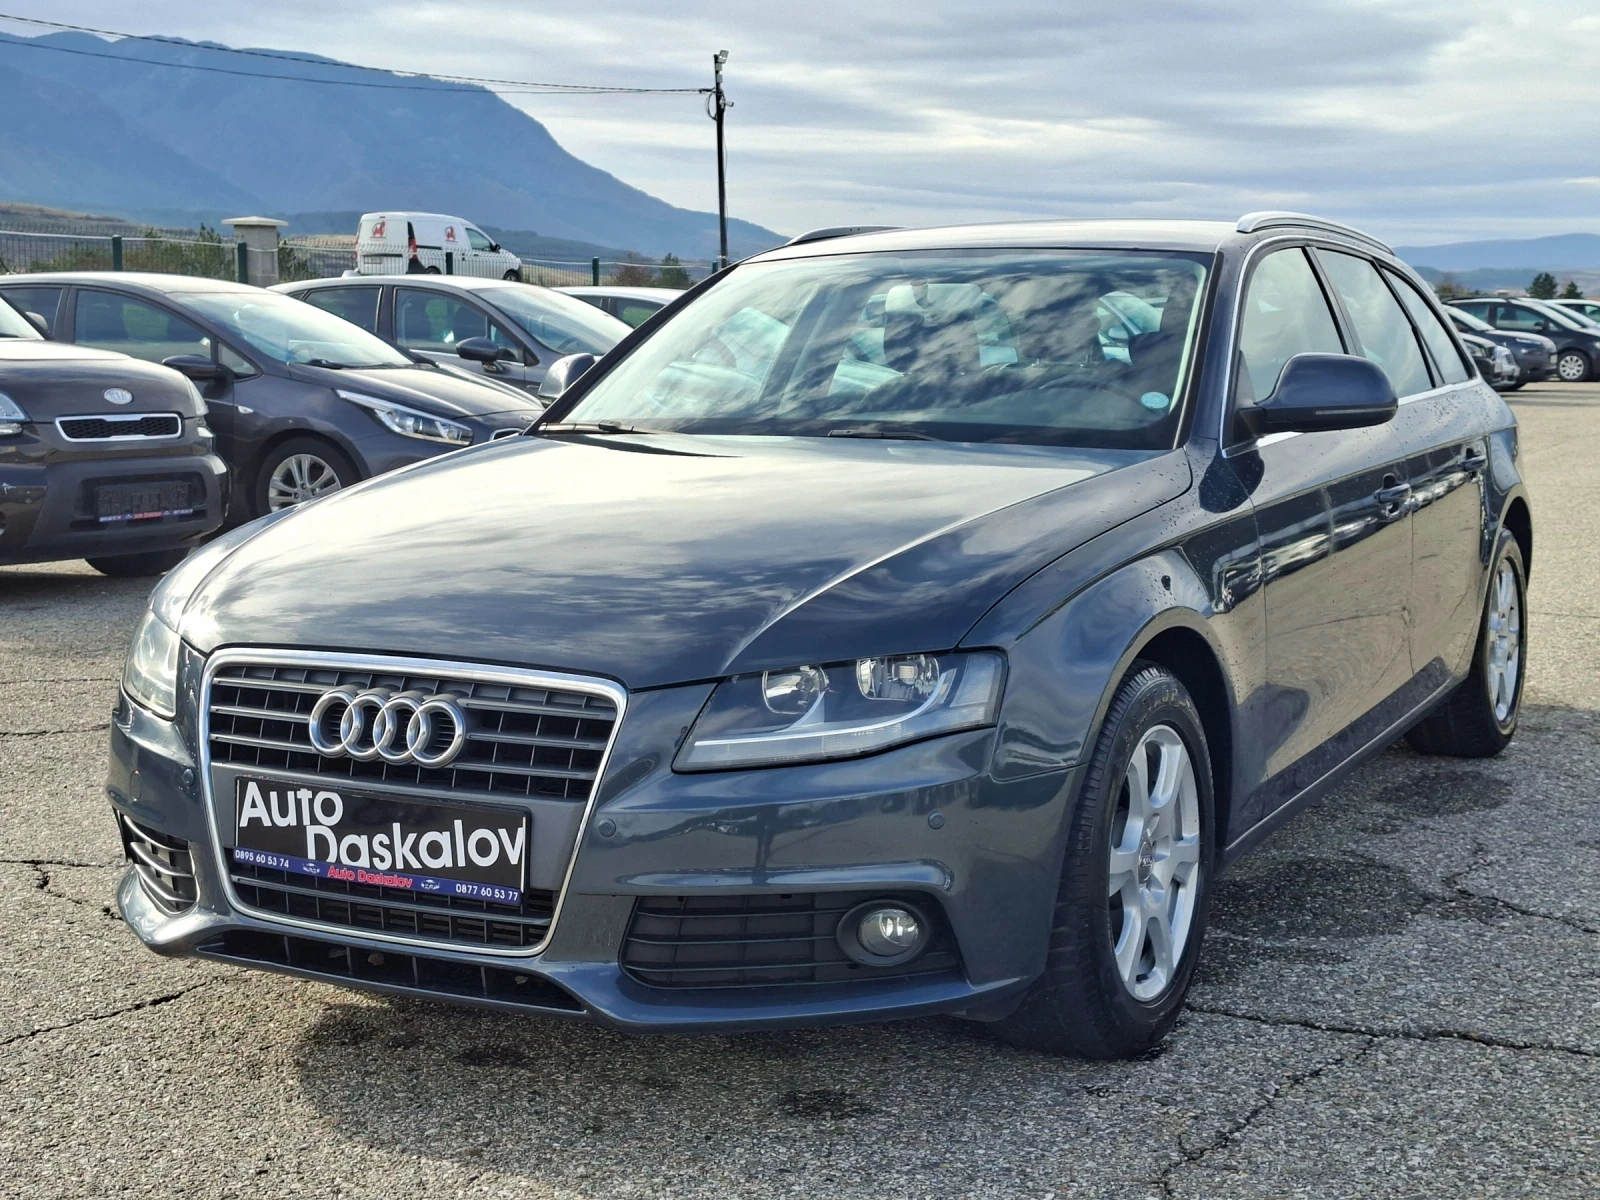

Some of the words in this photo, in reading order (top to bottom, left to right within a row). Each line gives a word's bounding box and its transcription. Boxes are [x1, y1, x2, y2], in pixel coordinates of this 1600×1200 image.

[239, 781, 344, 827] Auto
[305, 820, 523, 870] Daskalov
[235, 849, 254, 861] 0895
[256, 853, 266, 864] 60
[268, 856, 277, 866] 53
[280, 858, 289, 868] 74
[327, 866, 355, 881] Auto
[357, 869, 413, 888] Daskalov
[456, 884, 478, 894] 0877
[481, 887, 492, 897] 60
[494, 889, 505, 899] 53
[508, 892, 518, 901] 77
